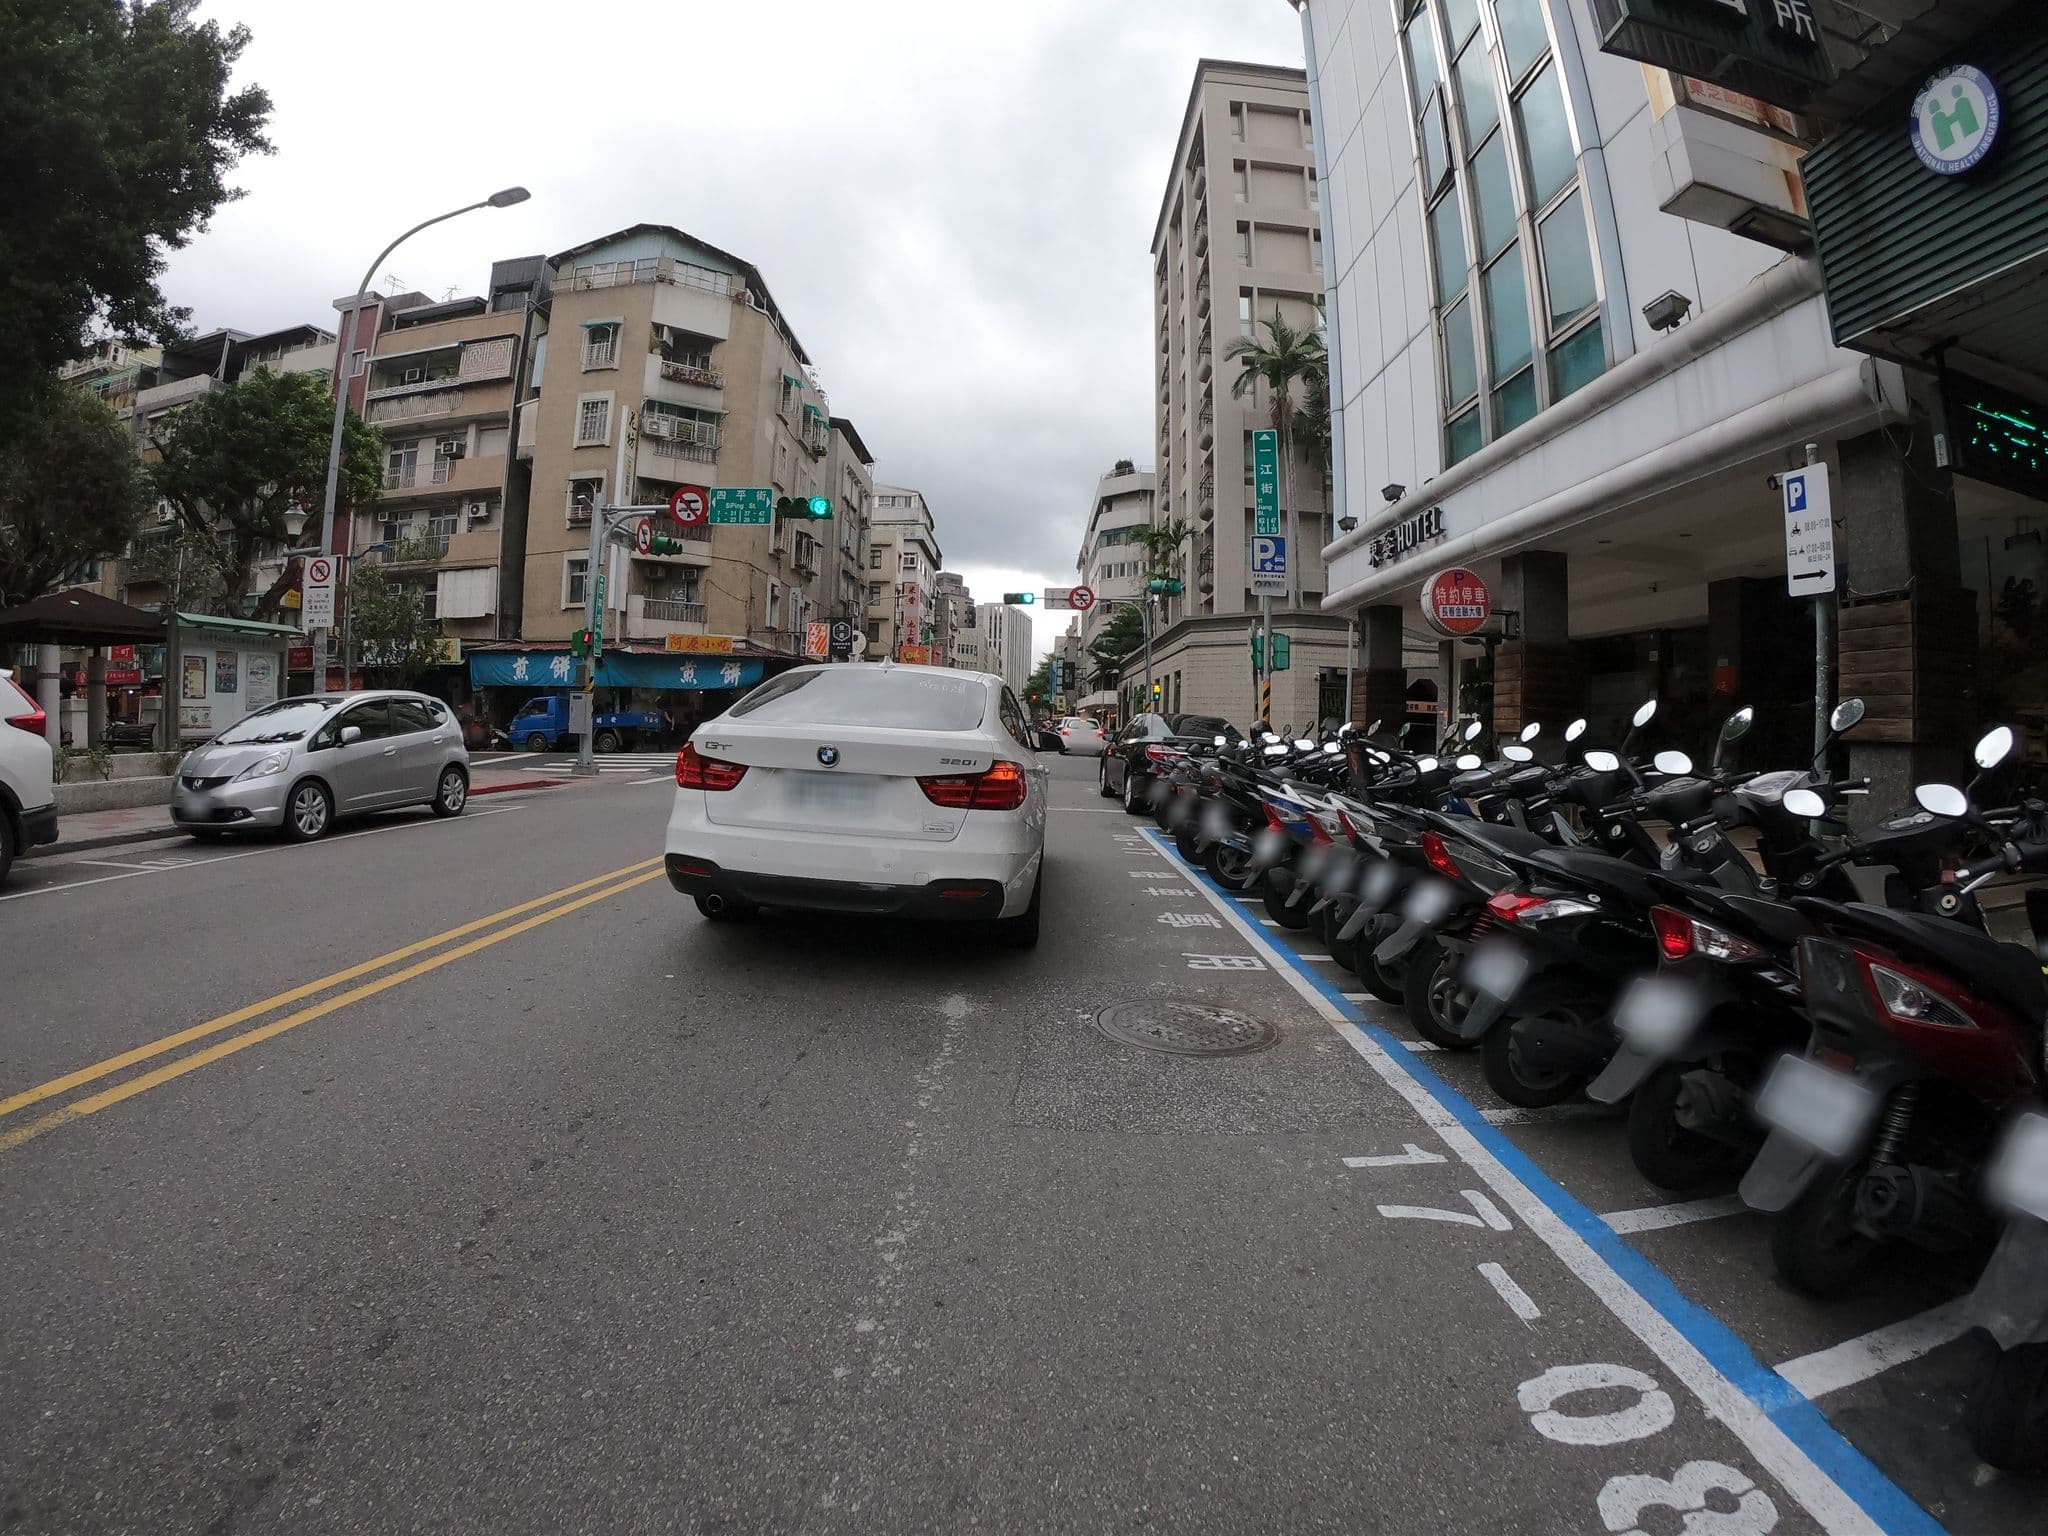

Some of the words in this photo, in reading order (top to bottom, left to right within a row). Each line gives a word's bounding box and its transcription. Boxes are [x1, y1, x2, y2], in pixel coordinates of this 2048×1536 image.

[1913, 137, 1945, 172] NATIONAL
[1948, 150, 1981, 172] HEALTH
[1980, 93, 1998, 154] INSURANCE
[1259, 449, 1273, 495] 一江街
[717, 490, 766, 501] 四平街
[1788, 481, 1802, 508] P
[1397, 506, 1444, 553] HOTEL
[1254, 538, 1275, 570] P
[1453, 572, 1465, 586] P
[1435, 587, 1486, 605] 特約停車
[705, 741, 733, 751] GT
